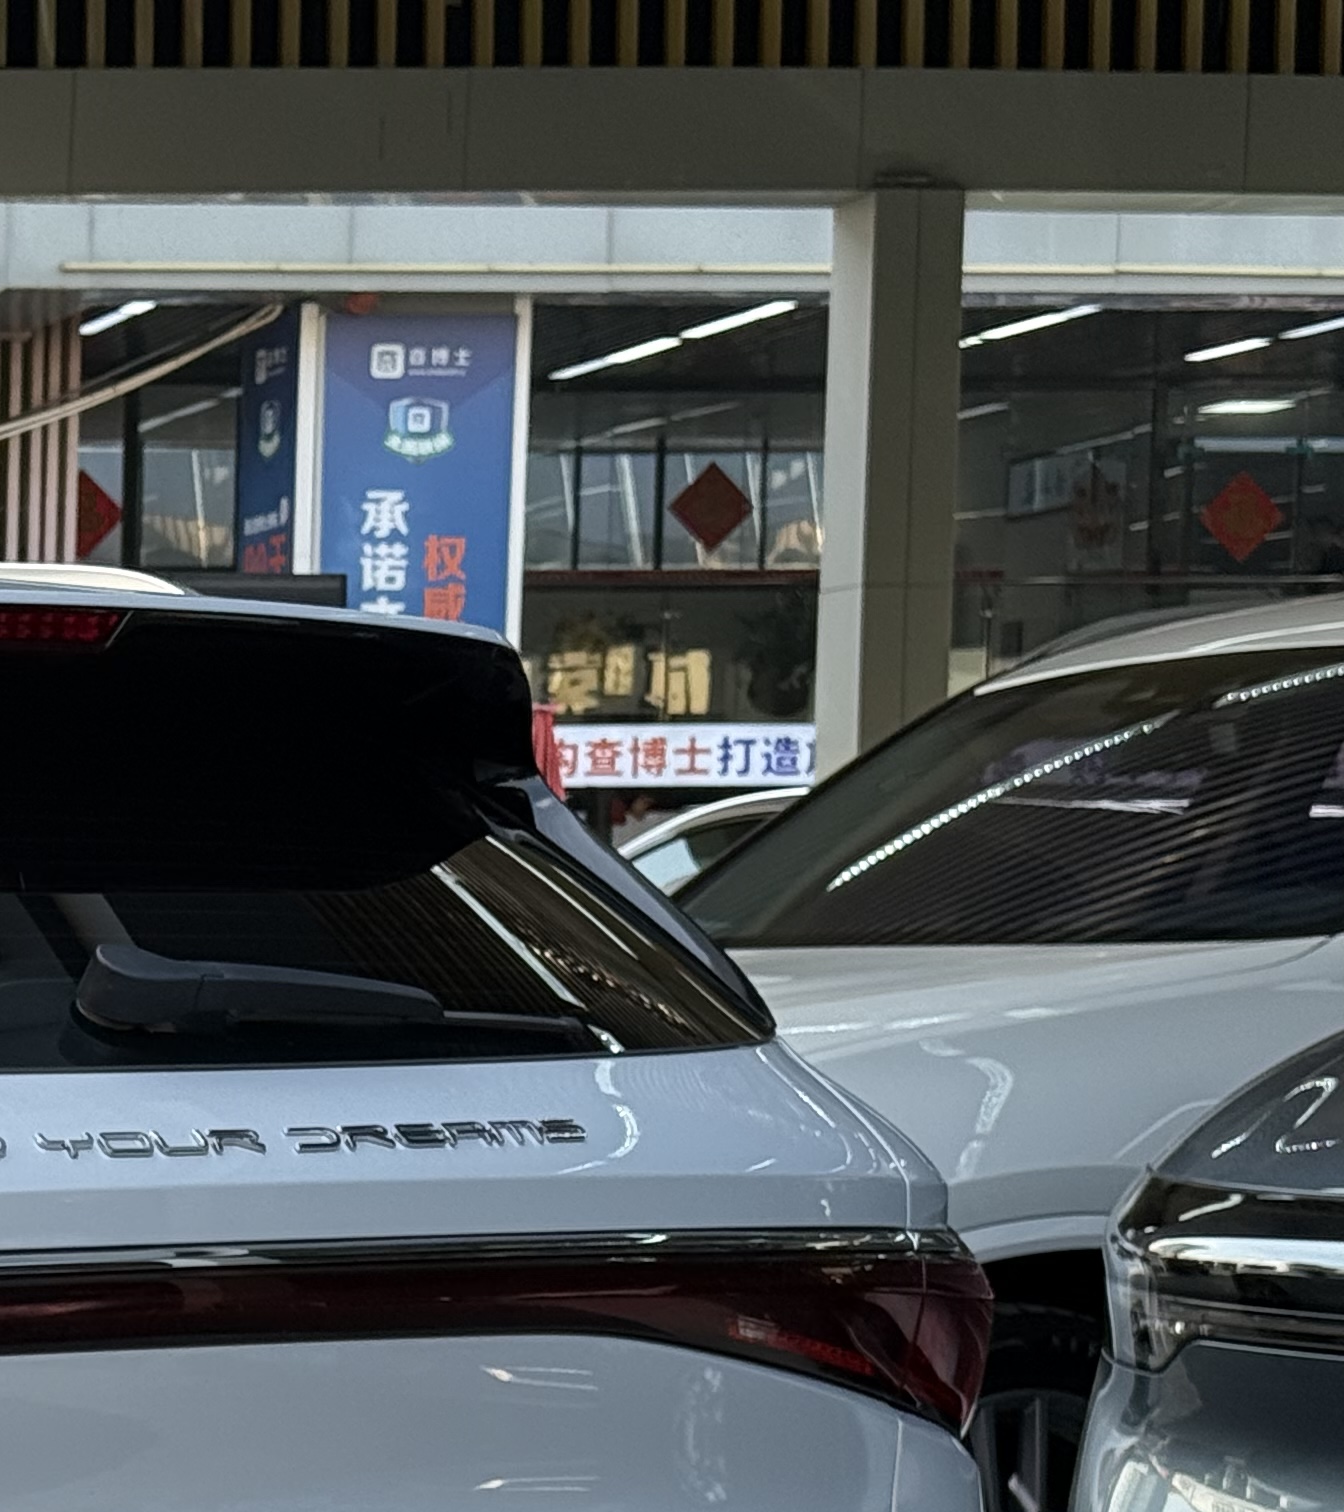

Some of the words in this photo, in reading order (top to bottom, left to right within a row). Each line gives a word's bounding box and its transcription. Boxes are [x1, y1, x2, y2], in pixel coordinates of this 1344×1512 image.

[423, 535, 467, 622] 权威
[34, 1127, 268, 1159] YOUR
[284, 1117, 589, 1156] DREAMS
